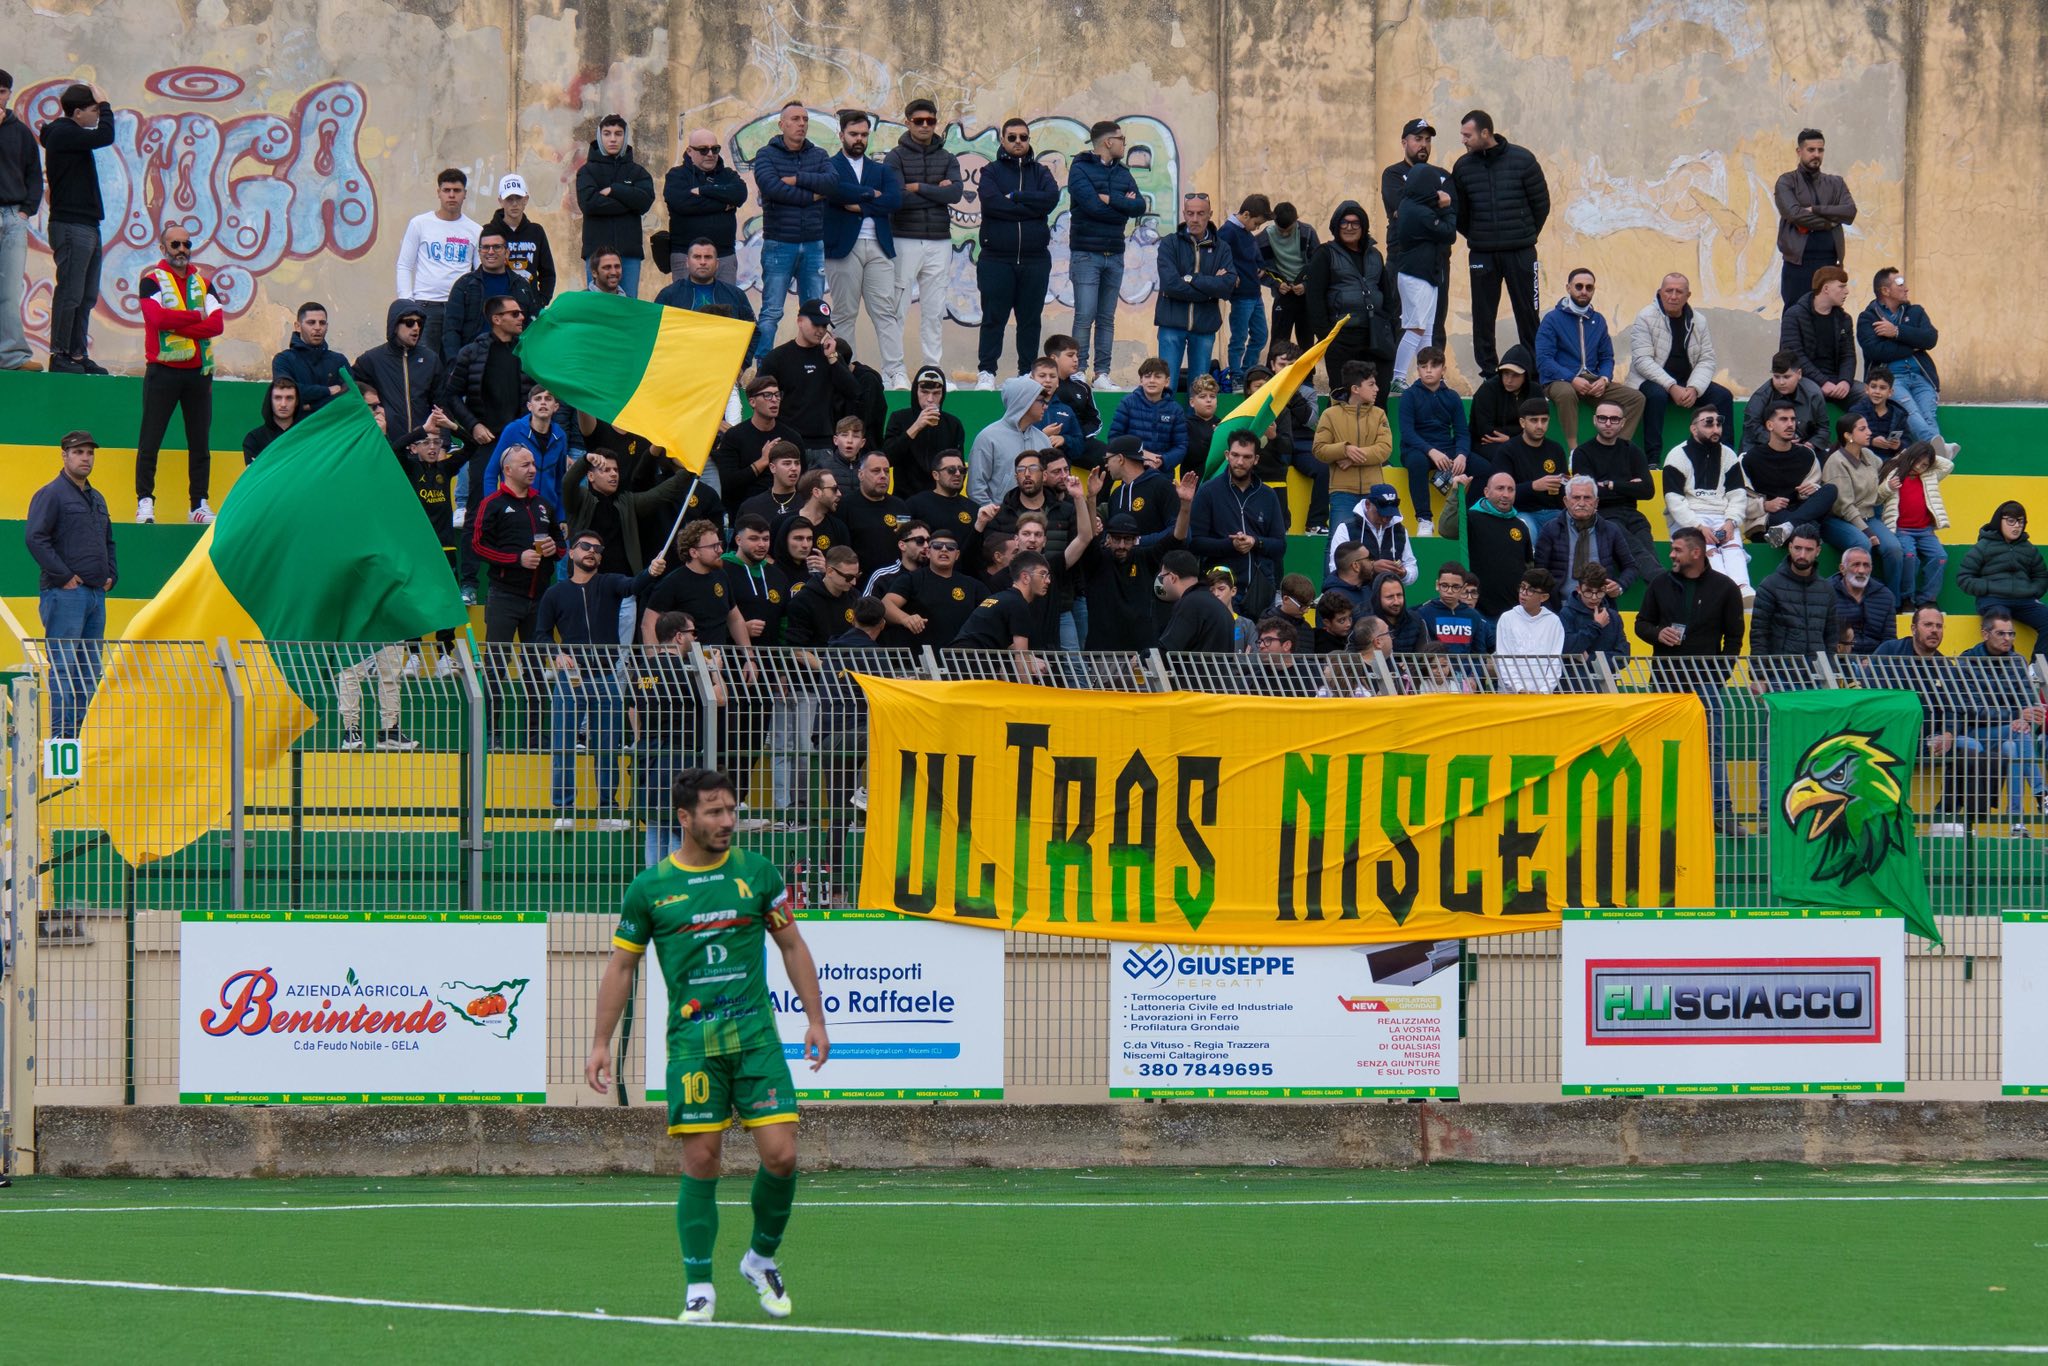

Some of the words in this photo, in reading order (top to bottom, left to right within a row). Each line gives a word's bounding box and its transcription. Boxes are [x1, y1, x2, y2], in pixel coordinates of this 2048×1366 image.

[51, 743, 78, 775] 10
[894, 722, 1222, 931] ULTRAS
[1276, 735, 1681, 926] NISCEMI
[1178, 957, 1294, 975] GIUSEPPE
[1177, 979, 1264, 987] FERGATT
[286, 985, 351, 997] AZIENDA
[354, 985, 429, 997] AGRICOLA
[200, 966, 447, 1037] Benintende
[848, 990, 955, 1013] Raffaele
[1131, 993, 1217, 1002] Termocoperture
[1673, 983, 1863, 1021] SCIACCO
[1131, 1003, 1186, 1011] Lattoneria
[1188, 1003, 1218, 1011] Civile
[1221, 1003, 1235, 1011] ed
[1237, 1003, 1293, 1011] Industriale
[1352, 1002, 1378, 1010] NEW
[1131, 1013, 1194, 1021] Lavorazioni
[1196, 1013, 1207, 1021] in
[1210, 1013, 1239, 1021] Ferro
[1131, 1023, 1187, 1031] Profilatura
[1190, 1023, 1240, 1031] Grondaie
[294, 1041, 315, 1050] C.da
[317, 1041, 348, 1050] Feudo
[350, 1041, 382, 1050] Nobile
[391, 1041, 419, 1050] GELA
[1123, 1041, 1147, 1049] C.da
[1150, 1041, 1184, 1049] Vituso
[1194, 1041, 1224, 1050] Regia
[1227, 1041, 1270, 1049] Trazzera
[1391, 1043, 1440, 1051] QUALSIASI
[1123, 1051, 1166, 1059] Niscemi
[1168, 1051, 1229, 1061] Caltagirone
[1139, 1063, 1178, 1076] 380
[1183, 1063, 1273, 1076] 7849695
[681, 1071, 709, 1104] 10
